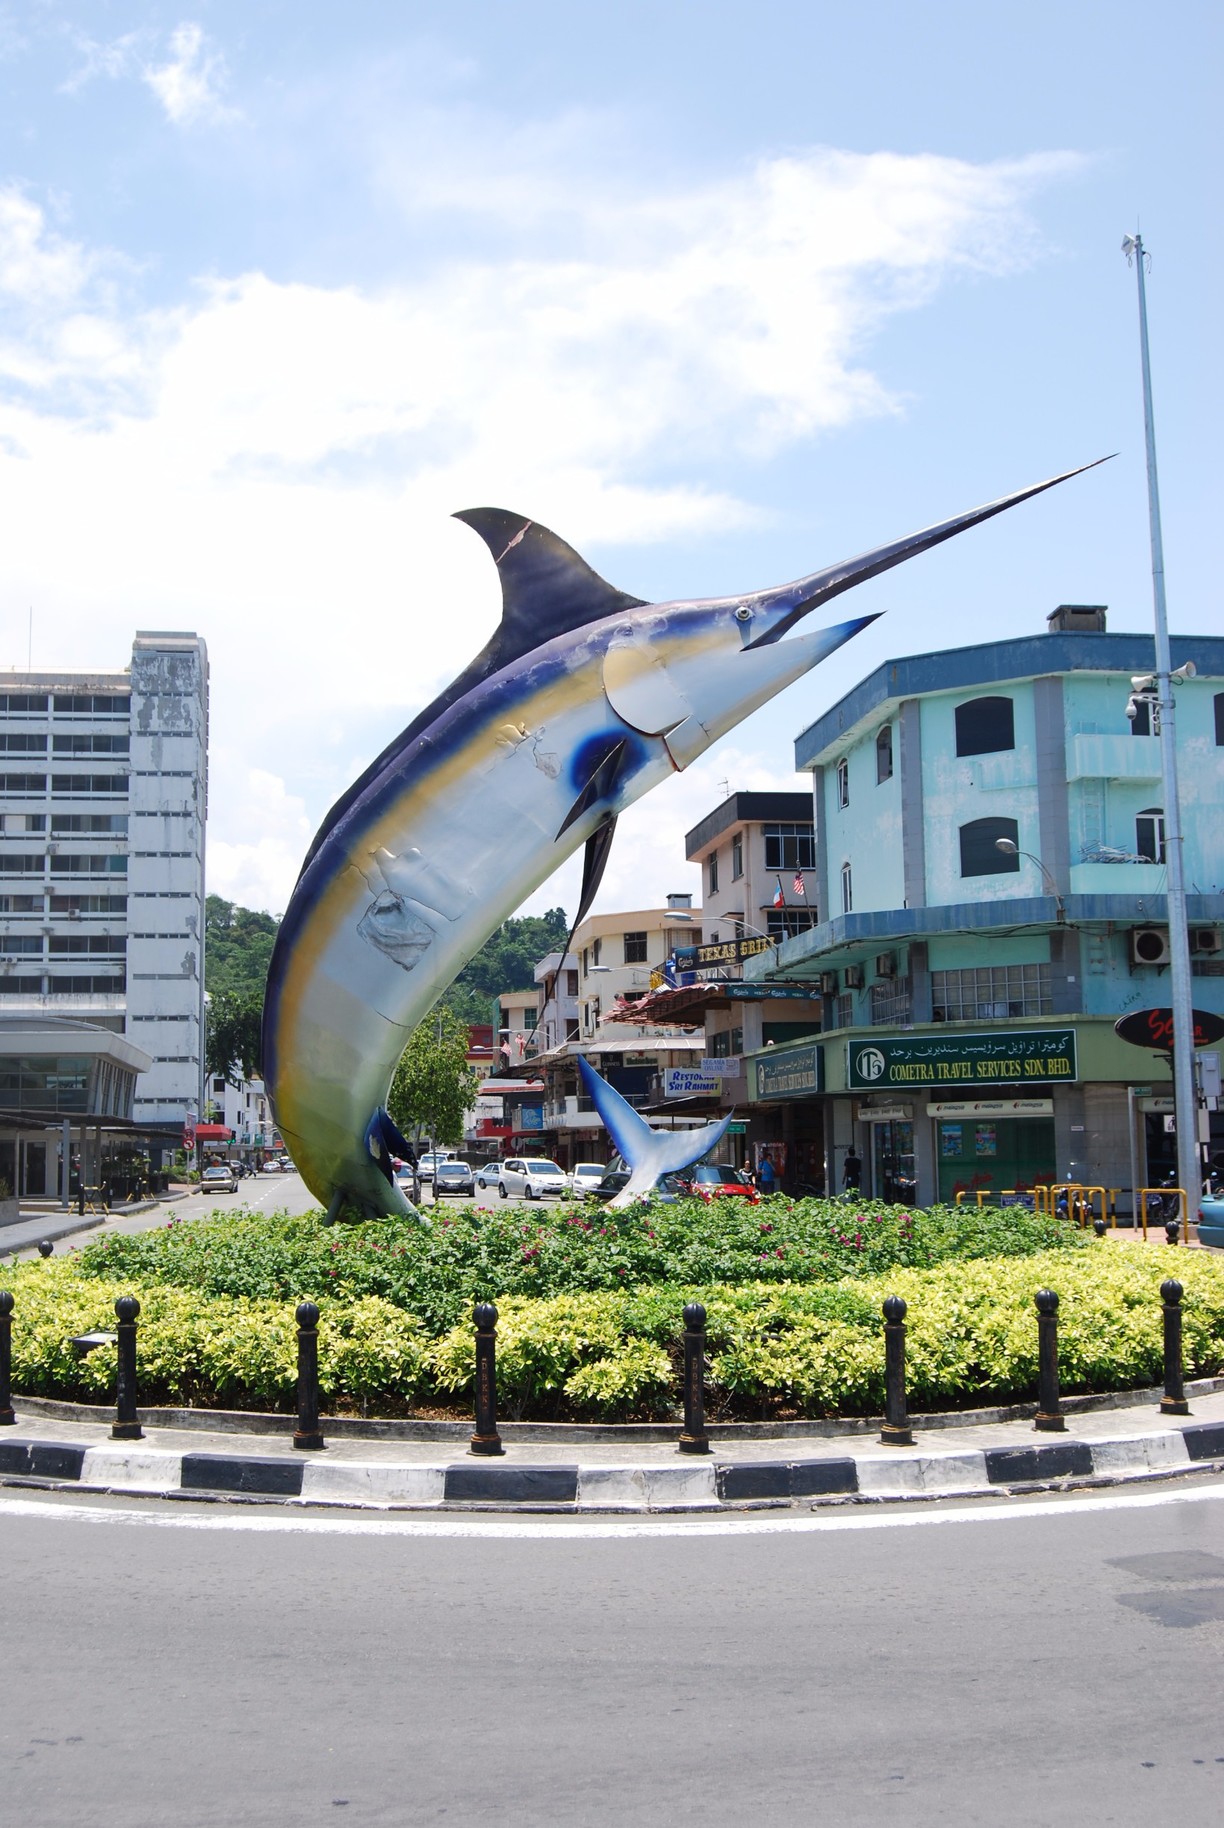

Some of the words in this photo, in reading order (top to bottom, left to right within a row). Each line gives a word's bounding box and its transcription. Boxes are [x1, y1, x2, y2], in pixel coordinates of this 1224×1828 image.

[698, 944, 736, 962] TEXAS
[889, 1064, 934, 1081] COMETRA
[936, 1062, 974, 1079] TRAVEL
[976, 1060, 1022, 1078] SERVICES
[1024, 1059, 1046, 1076] SDN.
[1047, 1058, 1071, 1075] BHD.
[668, 1081, 683, 1091] SRI
[684, 1081, 719, 1091] RAHMAT
